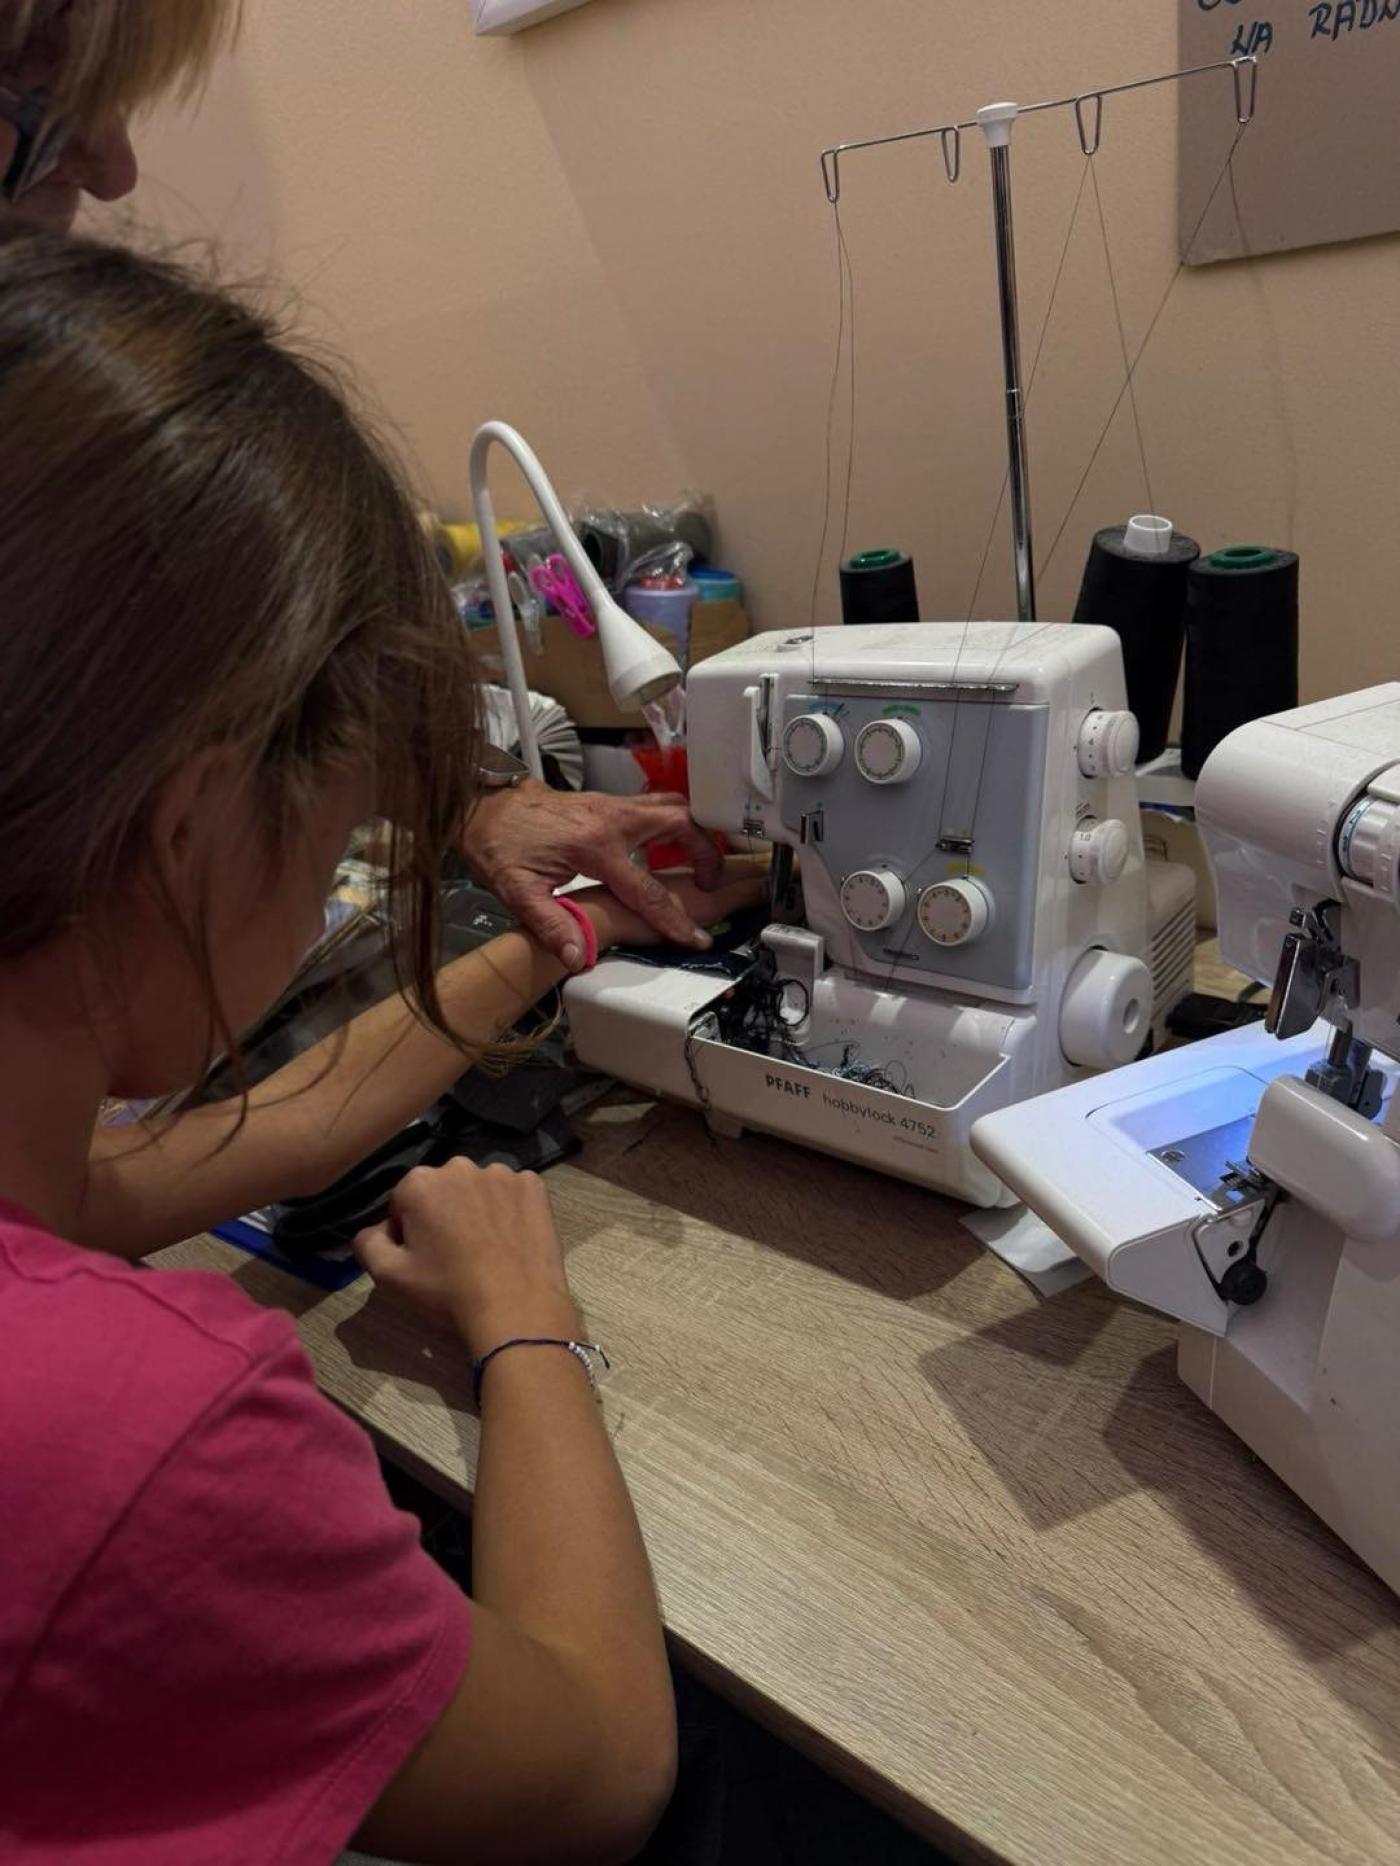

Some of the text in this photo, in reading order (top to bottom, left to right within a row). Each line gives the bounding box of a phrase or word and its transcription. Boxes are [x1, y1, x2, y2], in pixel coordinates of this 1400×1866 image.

[764, 1074, 937, 1139] PFAFF hobbylock 4752
